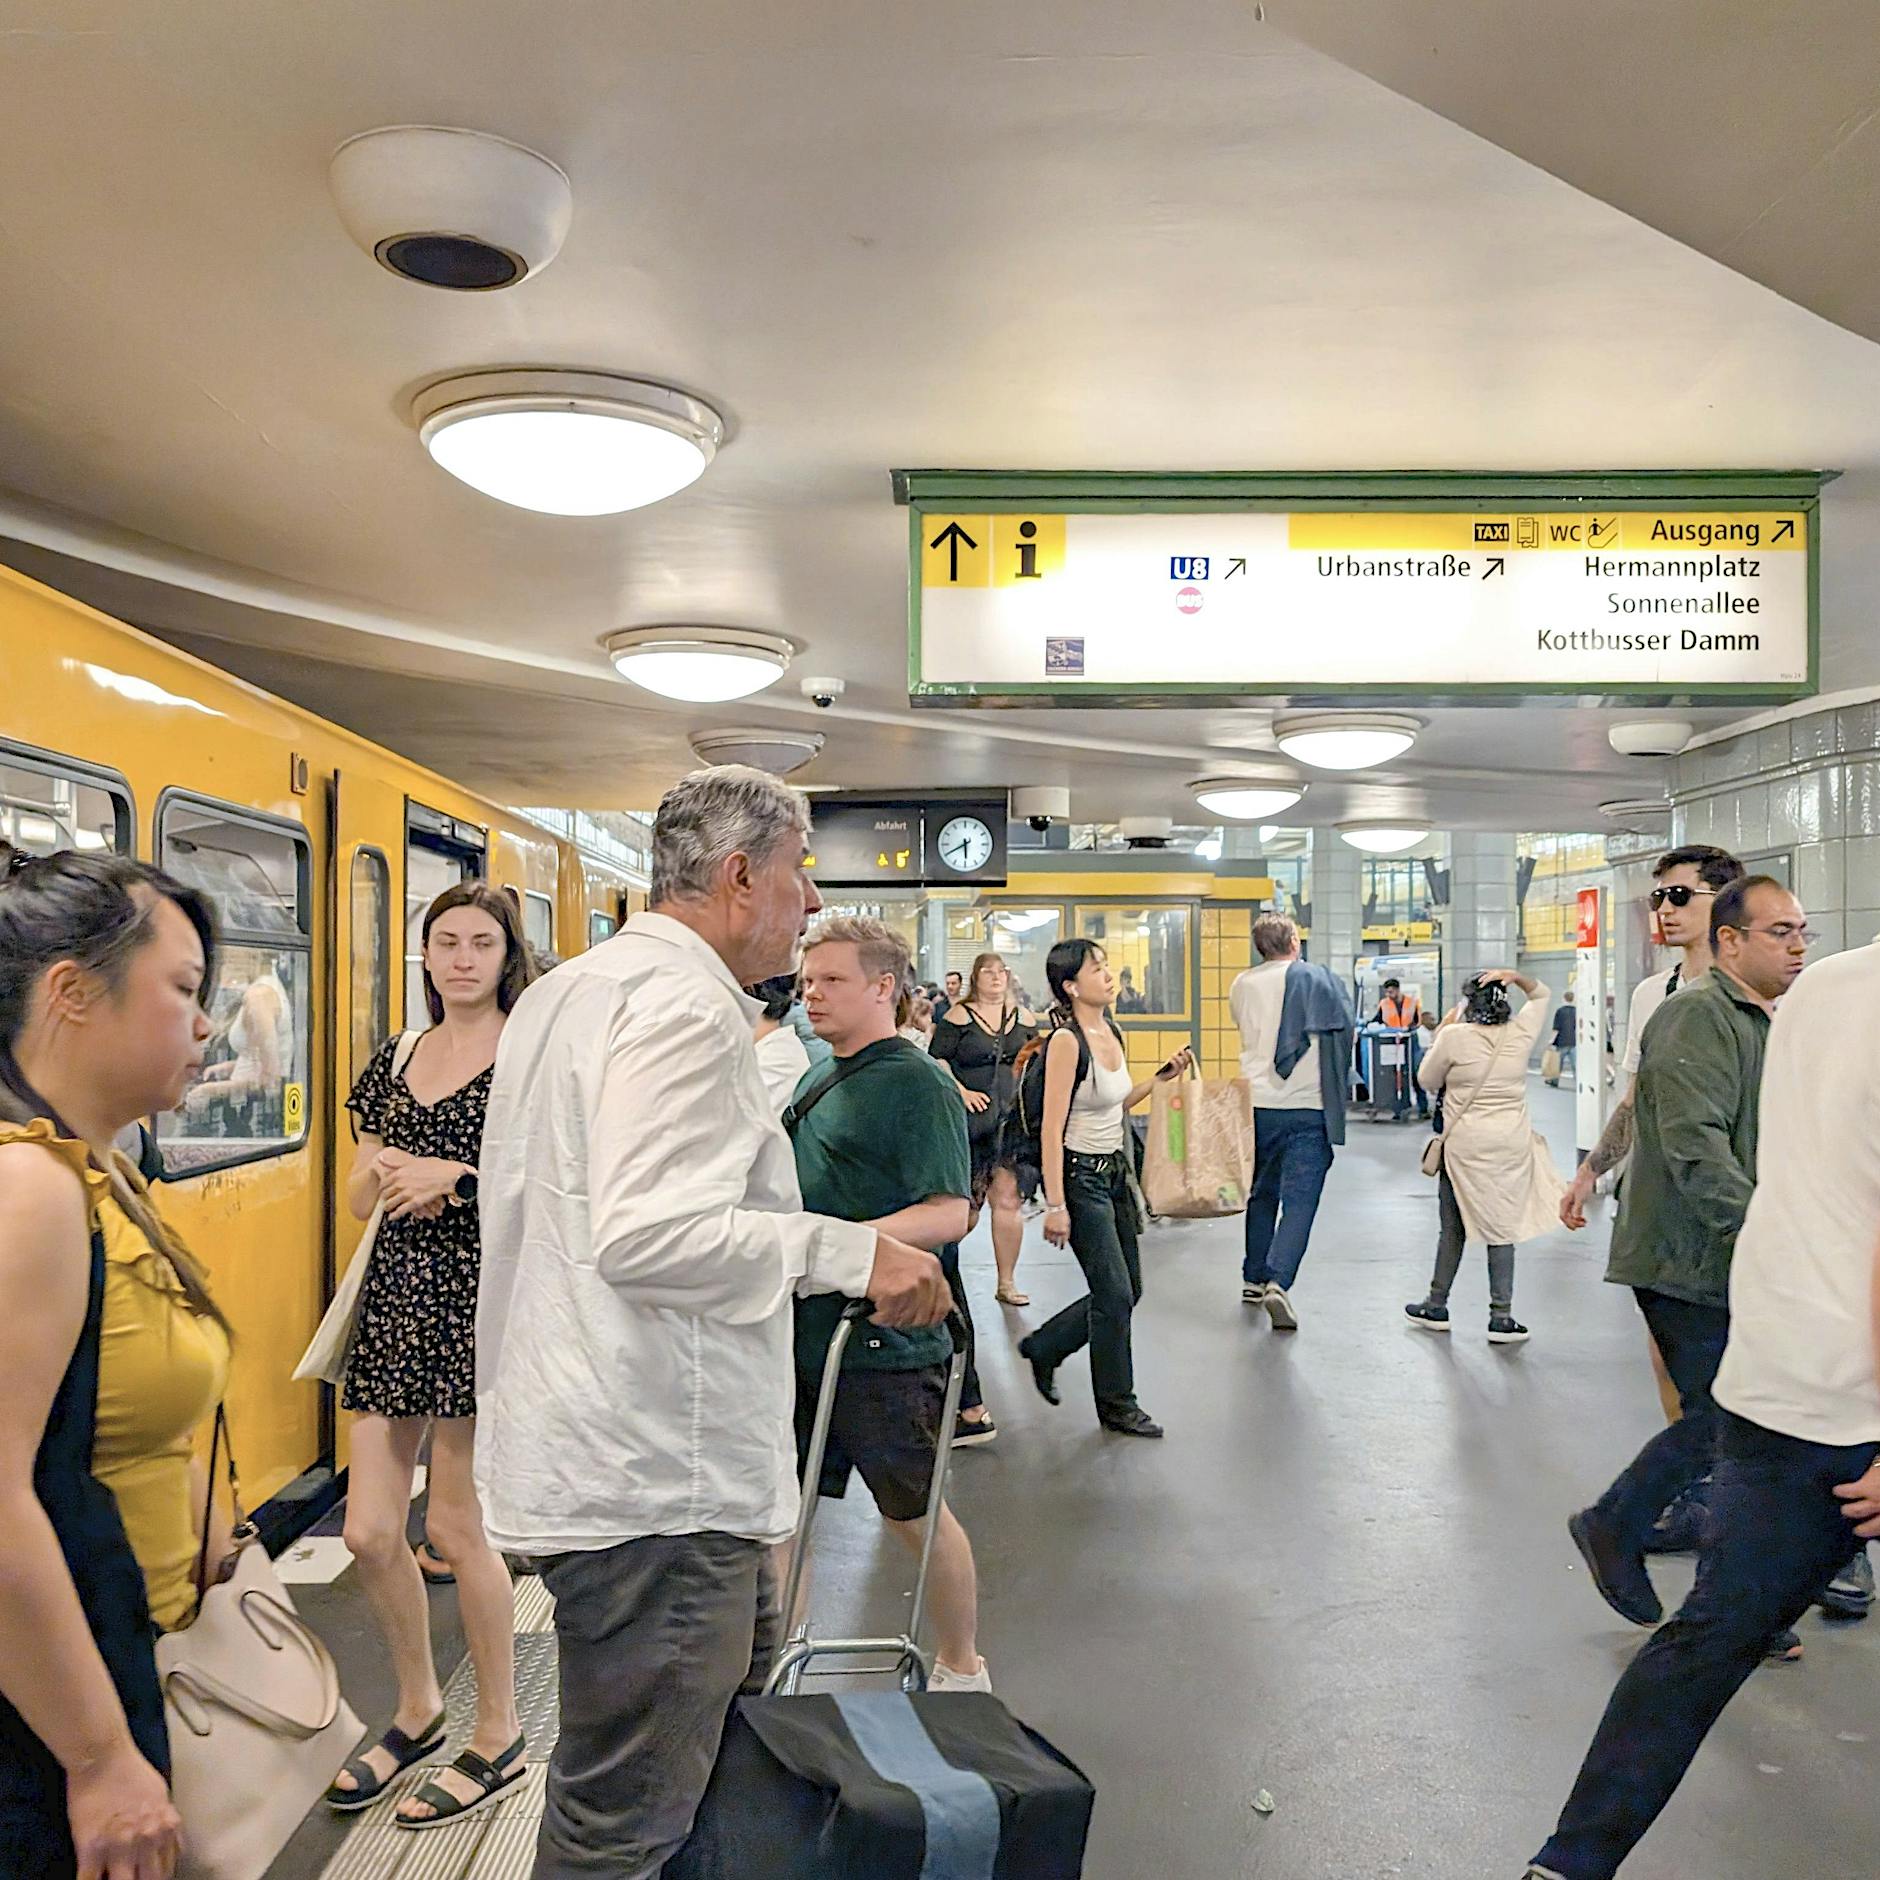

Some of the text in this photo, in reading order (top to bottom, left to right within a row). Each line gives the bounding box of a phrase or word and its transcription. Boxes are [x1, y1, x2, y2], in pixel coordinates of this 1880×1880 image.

[1475, 524, 1581, 542] TAXI WC
[1651, 519, 1760, 547] Ausgang
[1174, 558, 1207, 580] U8
[1317, 554, 1471, 577] Urbanstraße
[1585, 554, 1761, 583] Hermannplatz
[1607, 591, 1761, 615] Sonnenallee
[1537, 628, 1760, 651] Kottbusser Damm
[874, 821, 907, 830] Abfahrt
